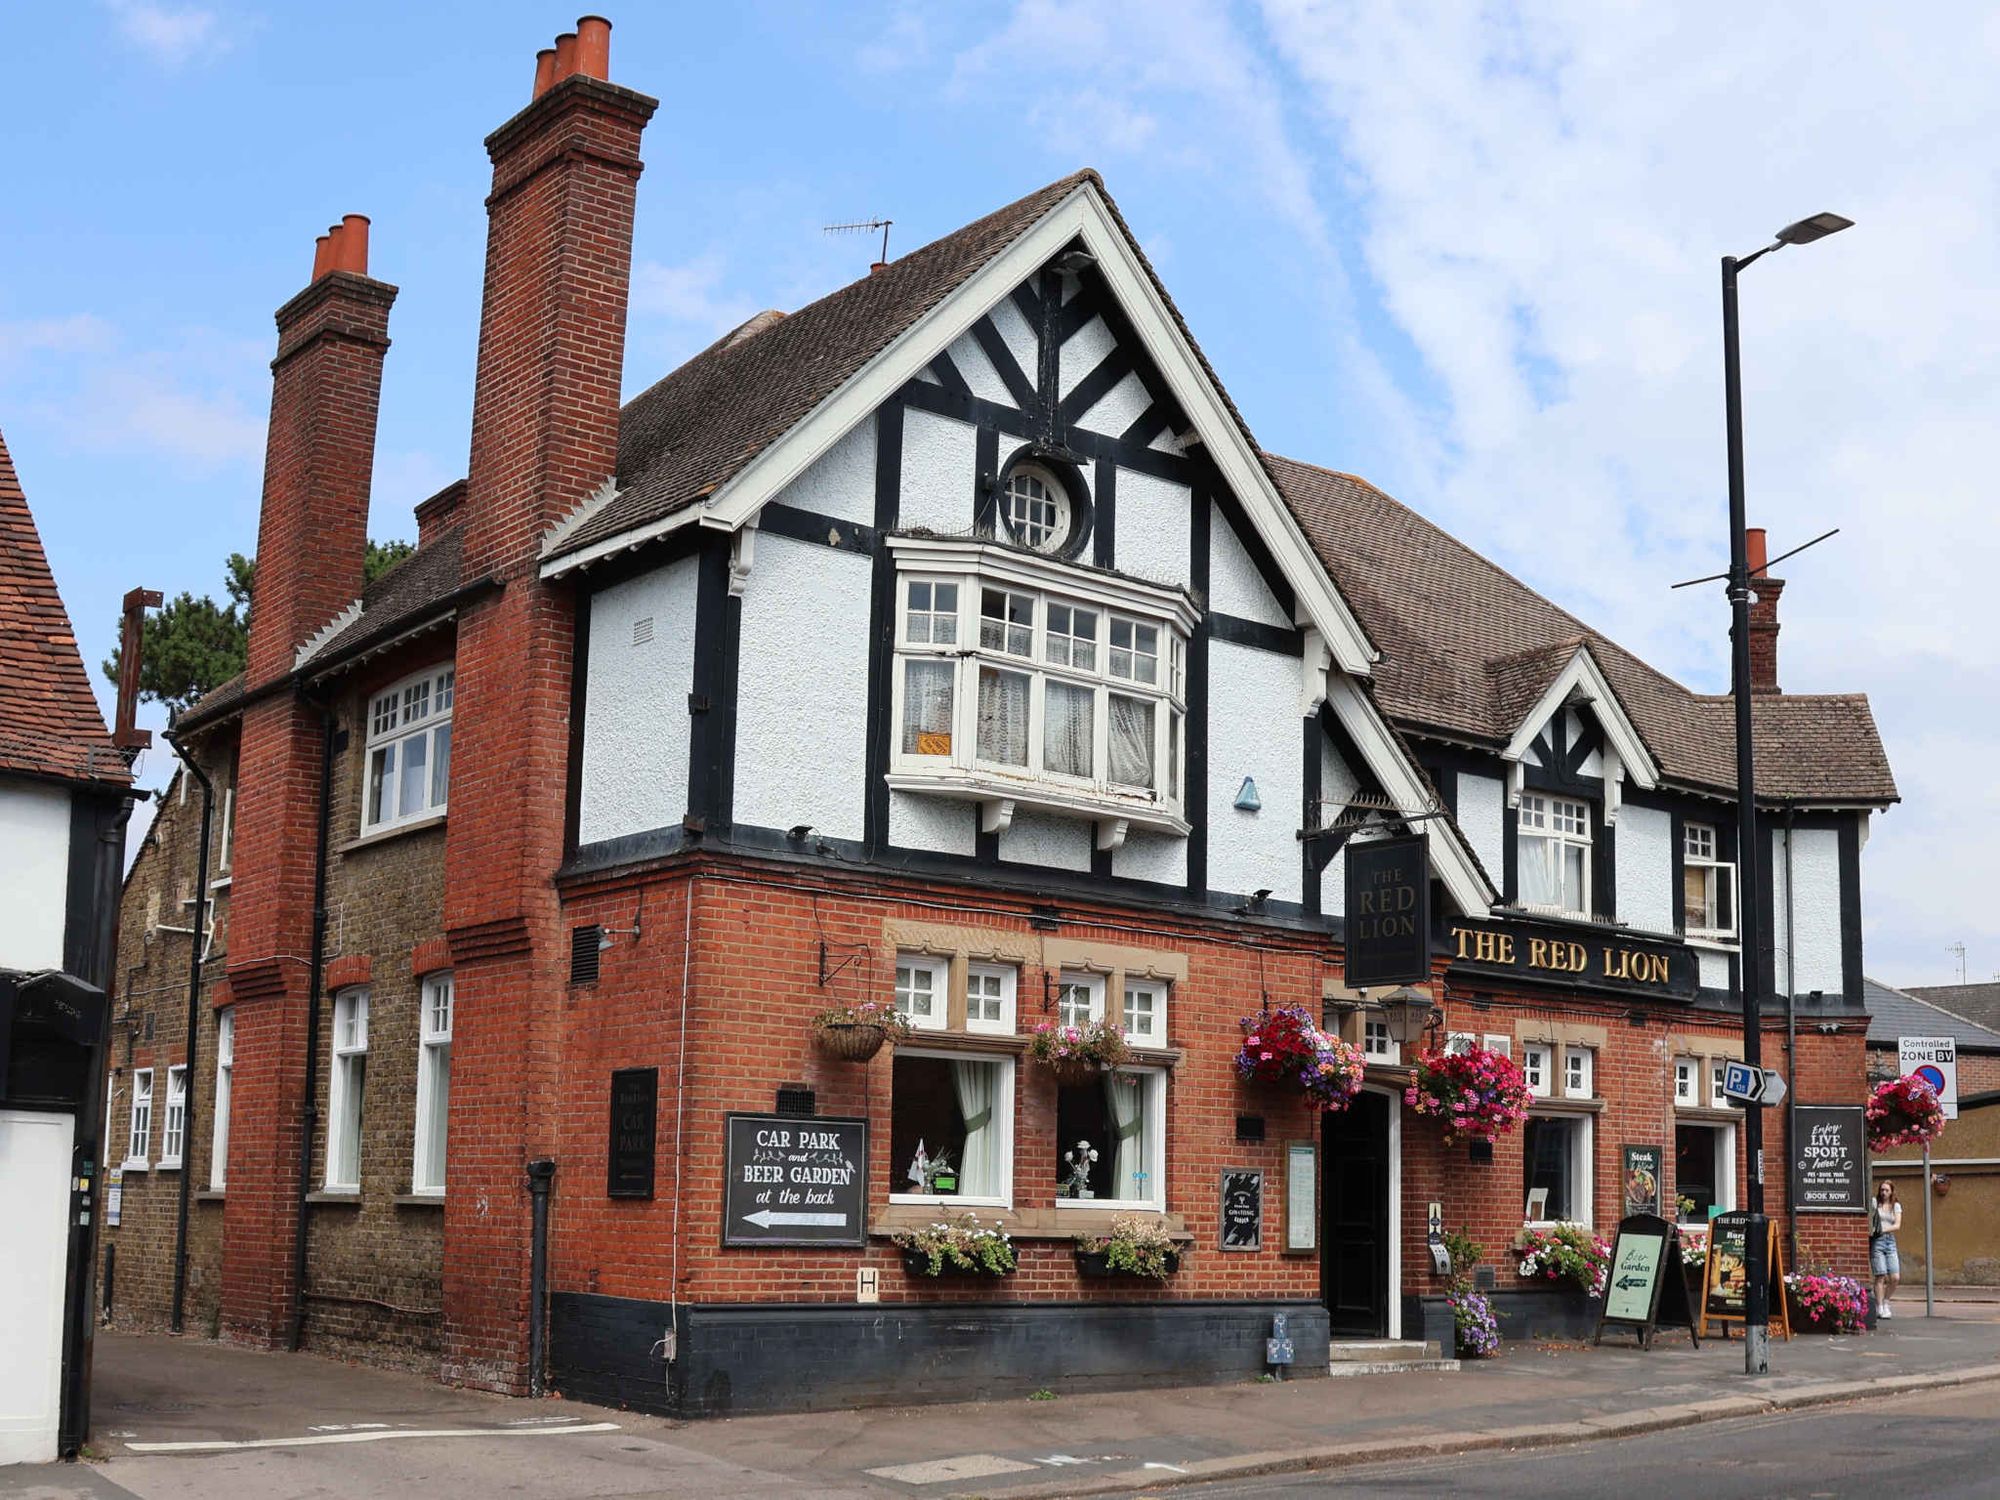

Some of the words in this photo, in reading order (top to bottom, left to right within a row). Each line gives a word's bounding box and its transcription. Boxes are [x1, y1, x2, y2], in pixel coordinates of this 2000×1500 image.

[1373, 868, 1402, 884] THE
[1360, 886, 1415, 915] RED
[1360, 915, 1415, 939] LION
[1451, 927, 1516, 964] THE
[1528, 937, 1588, 973] RED
[1603, 947, 1669, 984] LION
[1903, 1040, 1950, 1048] Controlled
[1901, 1051, 1934, 1060] ZONE
[1937, 1051, 1952, 1061] BV
[1729, 1069, 1742, 1089] P
[1811, 1123, 1842, 1135] Enjoy
[756, 1130, 791, 1148] CAR
[799, 1131, 840, 1150] PARK
[1811, 1134, 1840, 1146] LIVE
[788, 1152, 809, 1162] and
[1631, 1151, 1653, 1162] Steak
[1804, 1147, 1848, 1158] SPORT
[1812, 1158, 1840, 1169] here!
[743, 1165, 784, 1183] BEER
[790, 1166, 850, 1185] GARDEN
[756, 1188, 772, 1204] at
[779, 1187, 800, 1204] the
[804, 1188, 835, 1205] back
[1621, 1262, 1650, 1272] Garden
[861, 1271, 875, 1294] H
